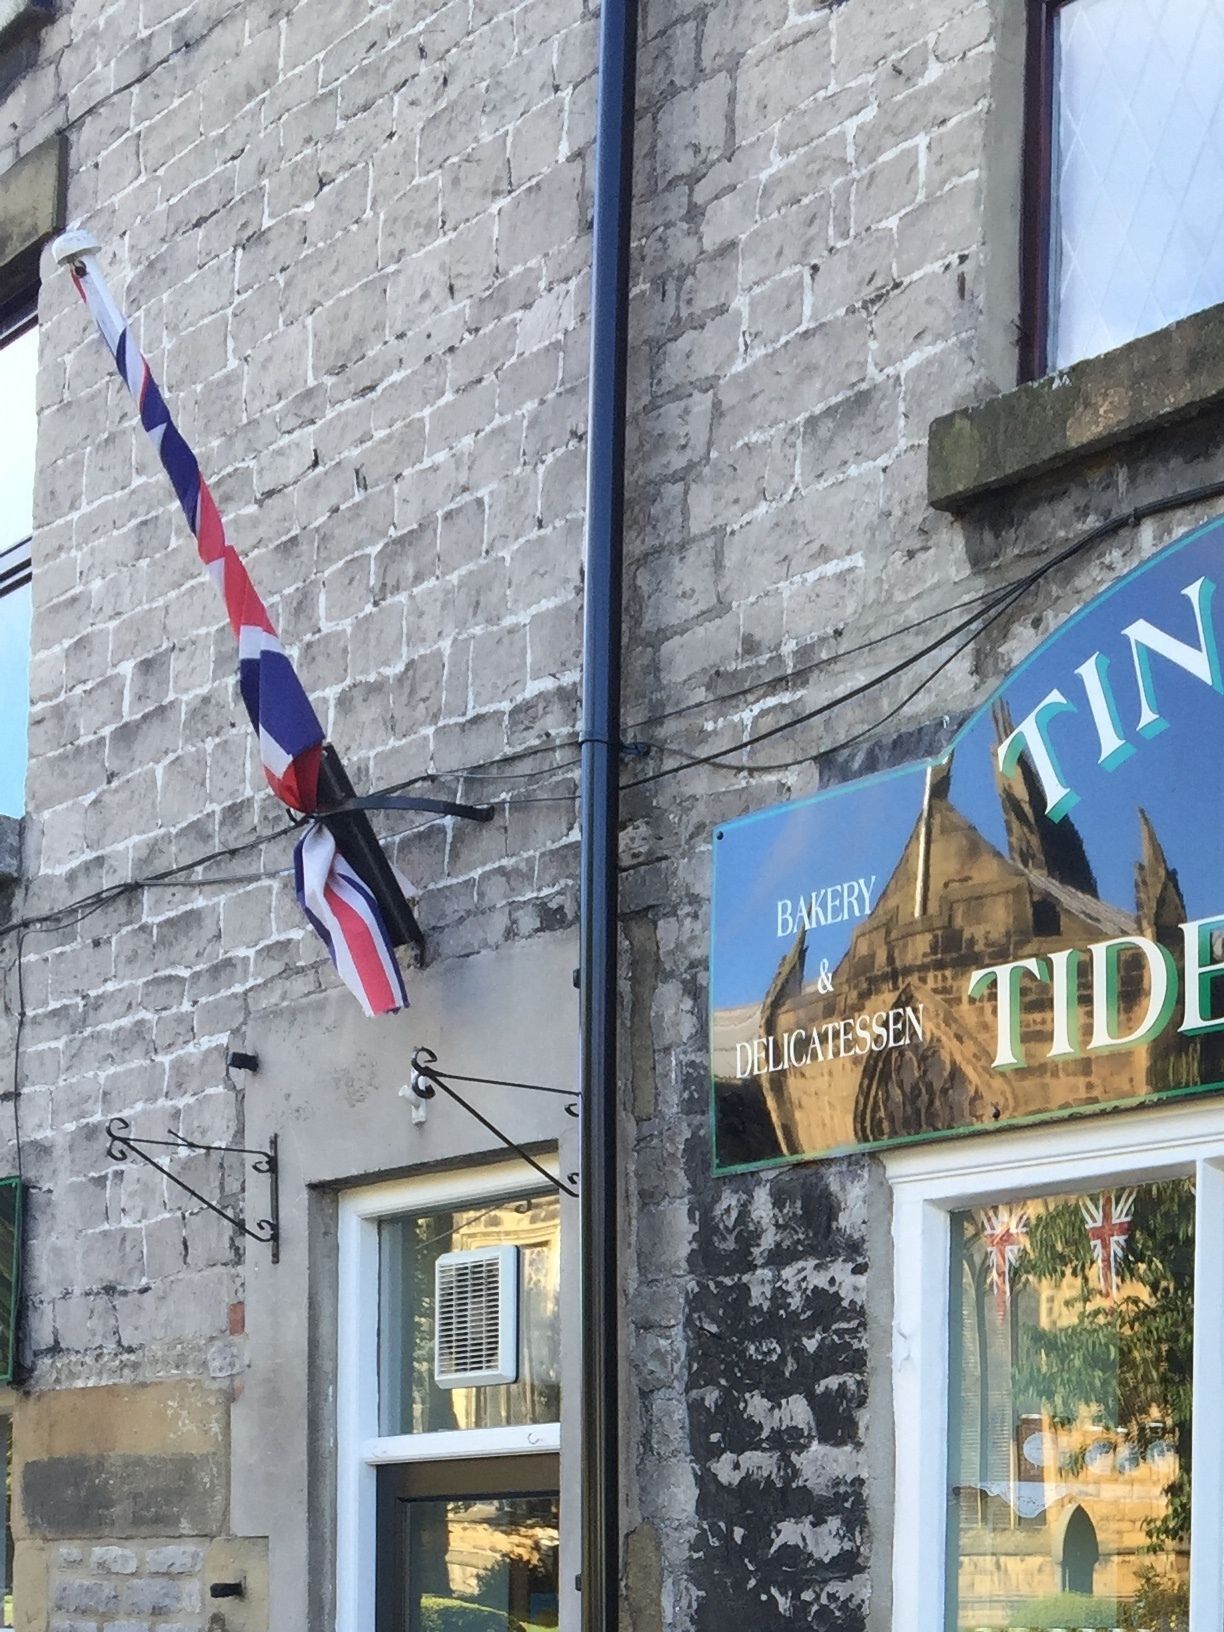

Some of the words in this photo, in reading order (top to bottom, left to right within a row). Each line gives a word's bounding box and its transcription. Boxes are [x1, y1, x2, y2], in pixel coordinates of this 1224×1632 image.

[775, 875, 877, 938] BAKERY
[816, 957, 835, 995] &
[734, 1003, 926, 1080] DELICATESSEN
